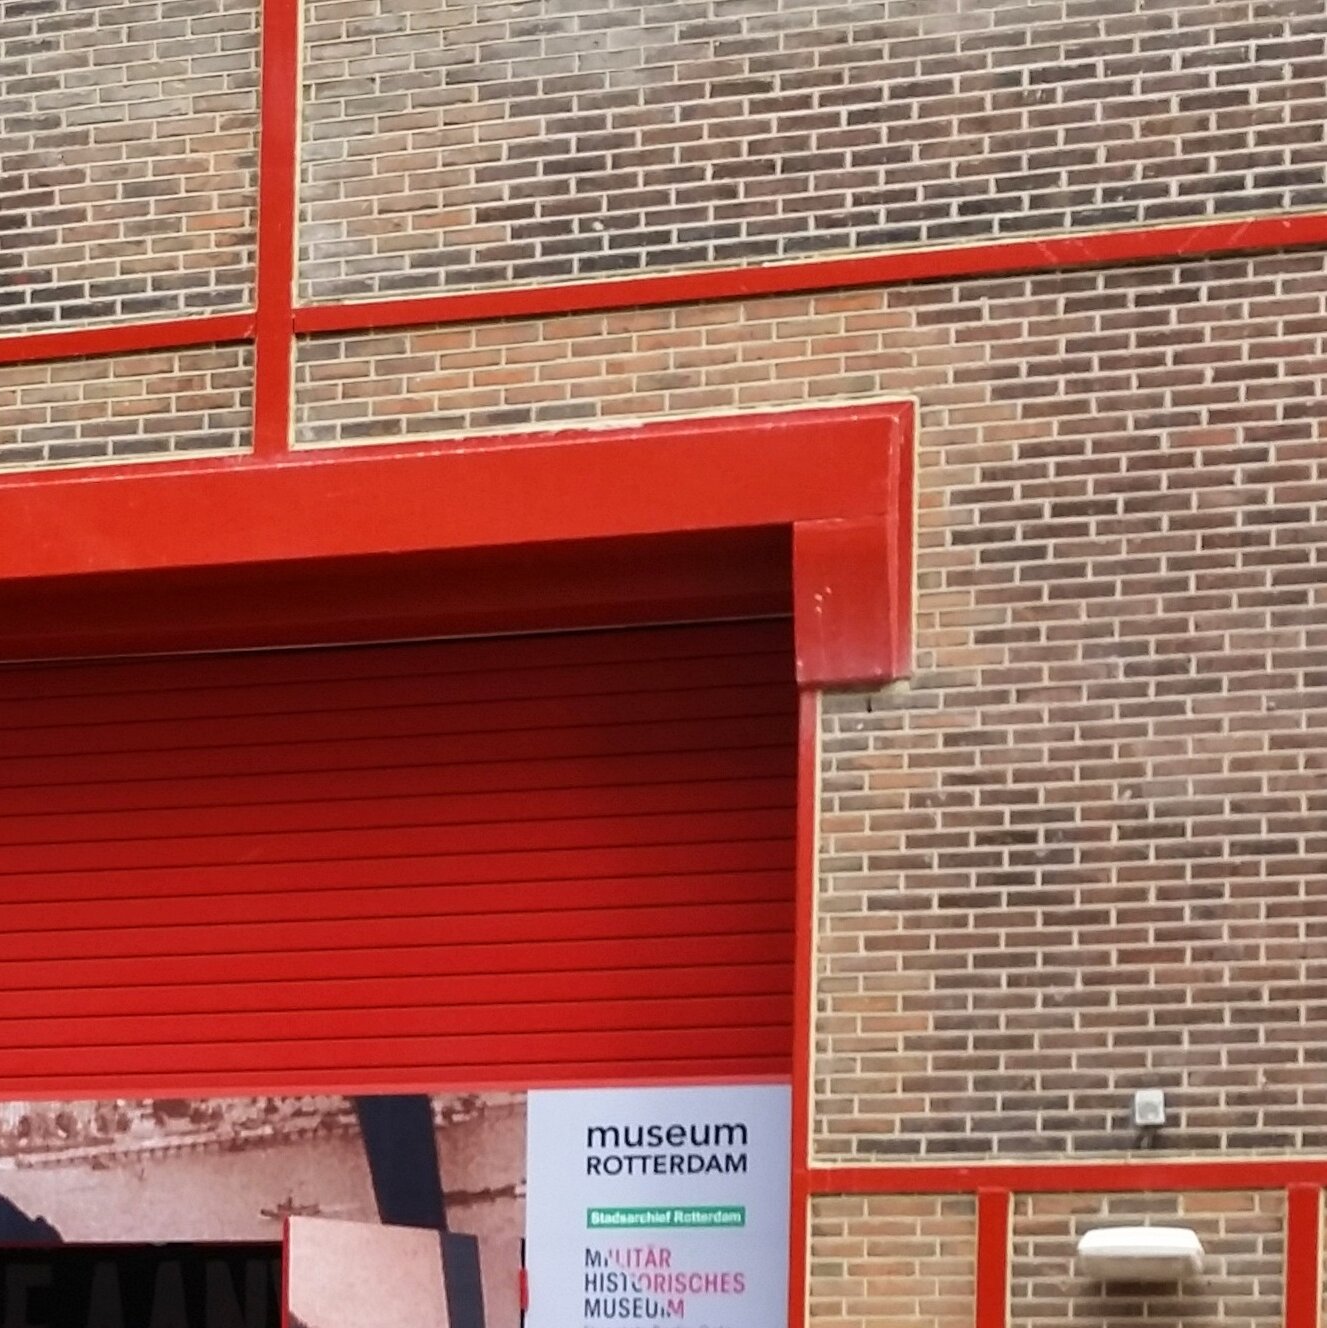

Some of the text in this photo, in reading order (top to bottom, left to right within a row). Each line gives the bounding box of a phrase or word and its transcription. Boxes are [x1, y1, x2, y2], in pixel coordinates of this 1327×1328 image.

[586, 1122, 749, 1148] museum
[586, 1153, 748, 1176] ROTTERDAM
[591, 1209, 742, 1225] Stadsarchief Rotterdam
[585, 1272, 746, 1293] HISTORISCHES
[584, 1297, 684, 1319] MUSEUM
